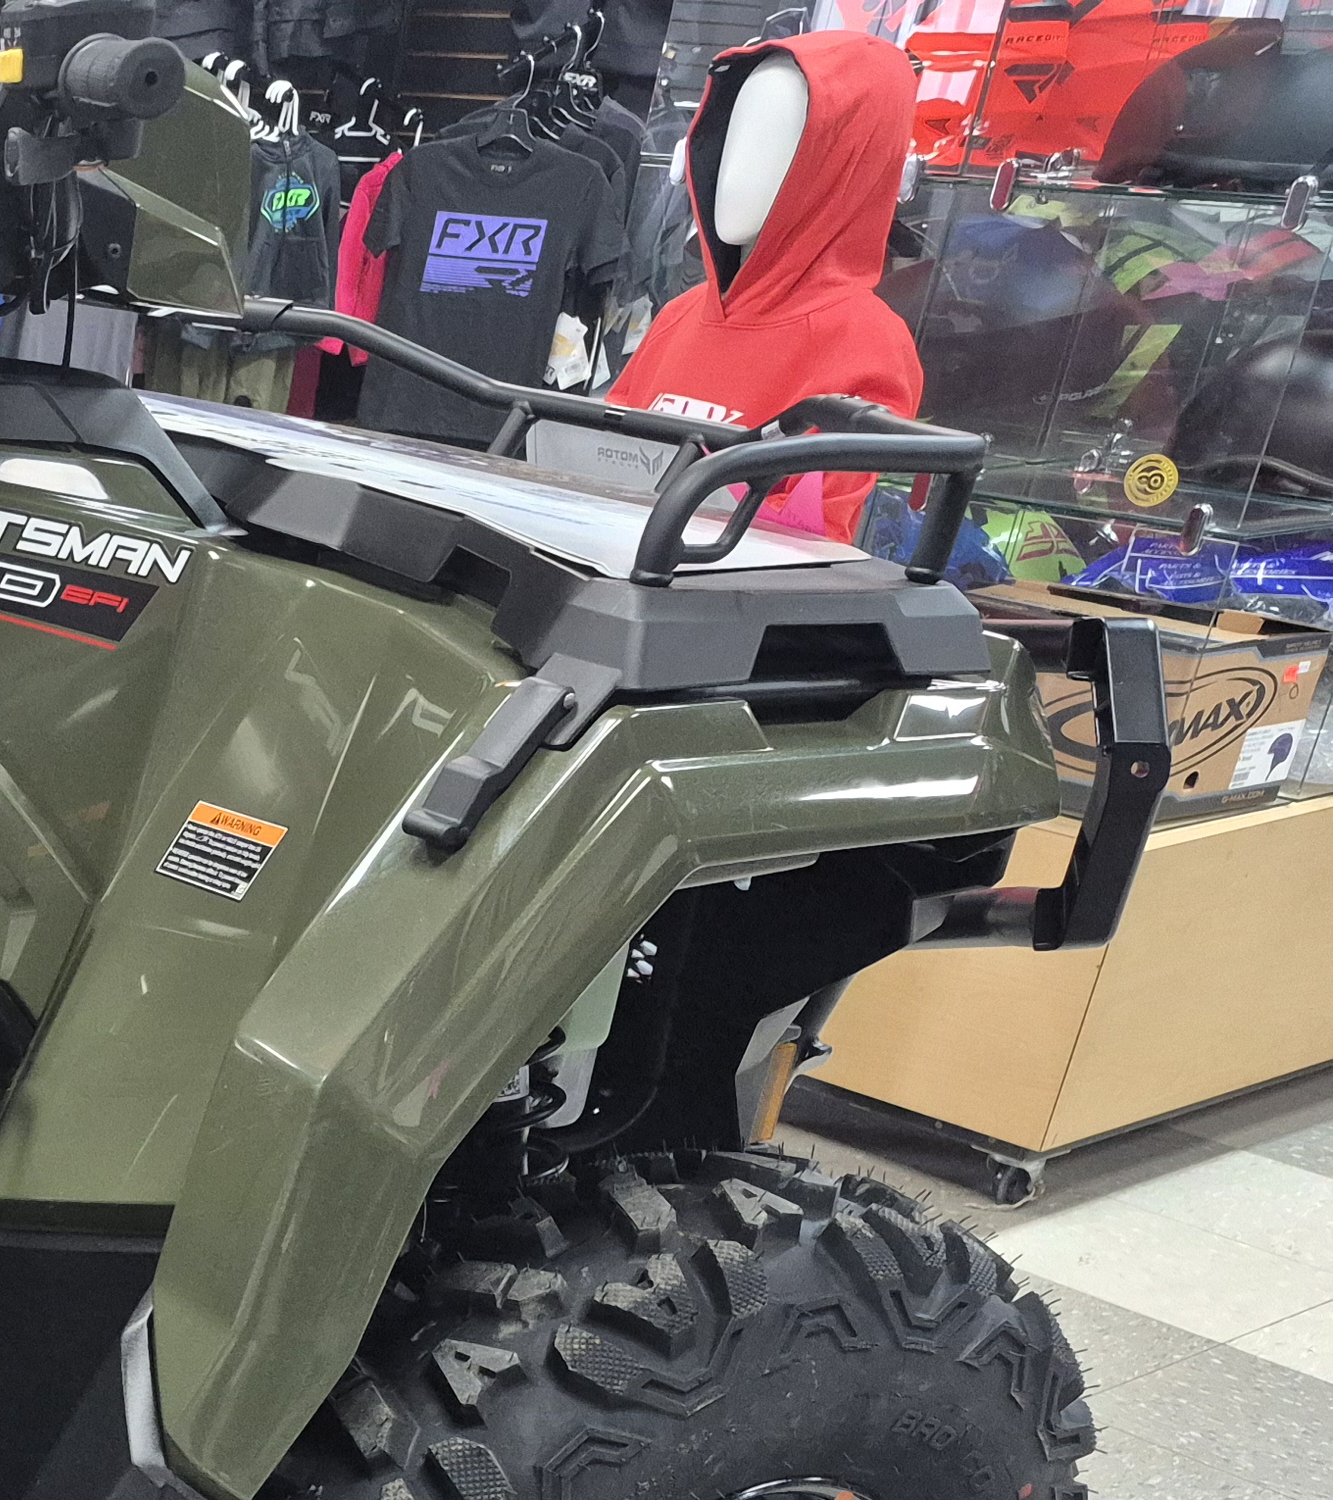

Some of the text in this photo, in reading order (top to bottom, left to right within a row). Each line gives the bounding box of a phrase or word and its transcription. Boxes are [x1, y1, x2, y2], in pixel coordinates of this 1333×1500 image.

[435, 217, 542, 257] FXR
[60, 584, 130, 613] EFI
[219, 812, 262, 837] WARNING
